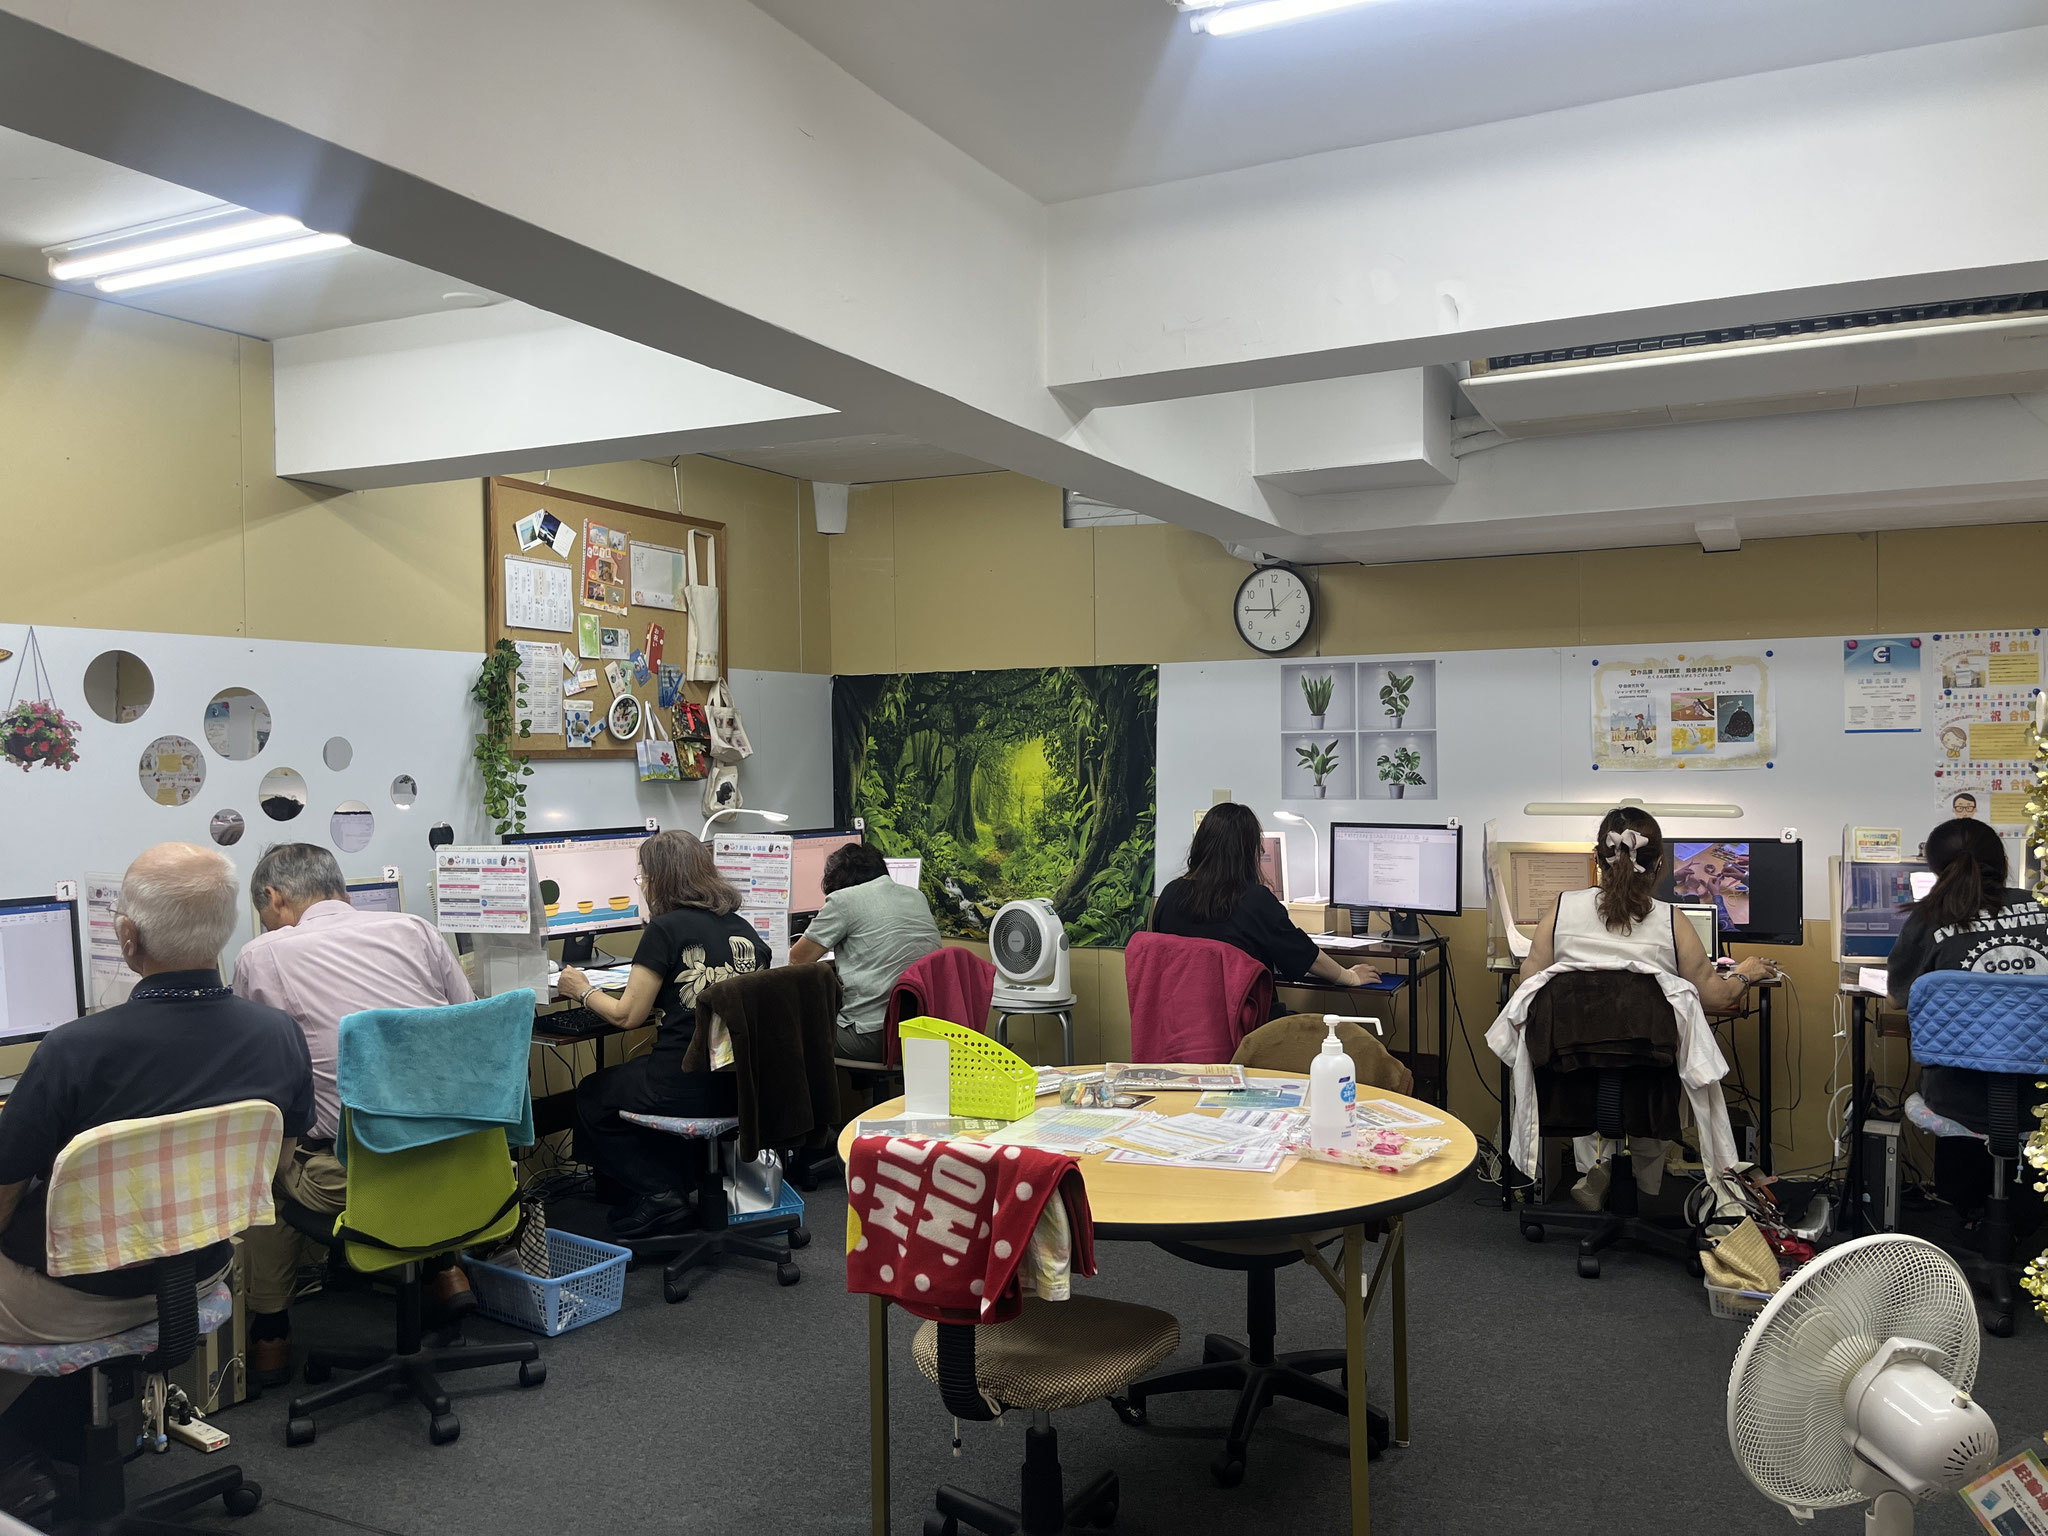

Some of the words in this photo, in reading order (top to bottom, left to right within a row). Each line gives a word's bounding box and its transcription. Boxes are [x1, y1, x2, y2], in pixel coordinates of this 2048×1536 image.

[1270, 574, 1278, 583] 12
[1258, 579, 1264, 588] 11
[1247, 590, 1255, 599] 10
[1296, 589, 1301, 598] 2
[1300, 605, 1305, 614] 3
[1248, 620, 1253, 630] 8
[1295, 620, 1301, 628] 4
[1258, 631, 1263, 640] 7
[1271, 636, 1276, 644] 6
[1285, 631, 1290, 640] 5
[1989, 641, 2000, 652] 祝
[1990, 710, 2001, 722] 祝
[1991, 779, 2002, 791] 祝
[649, 820, 654, 828] 3
[1450, 818, 1456, 827] 4
[1785, 831, 1793, 840] 6
[387, 869, 396, 880] 2
[61, 885, 69, 896] 1
[1997, 901, 2040, 918] ARE
[1933, 913, 2048, 944] EVERYWHE
[1984, 956, 2036, 973] GOOD
